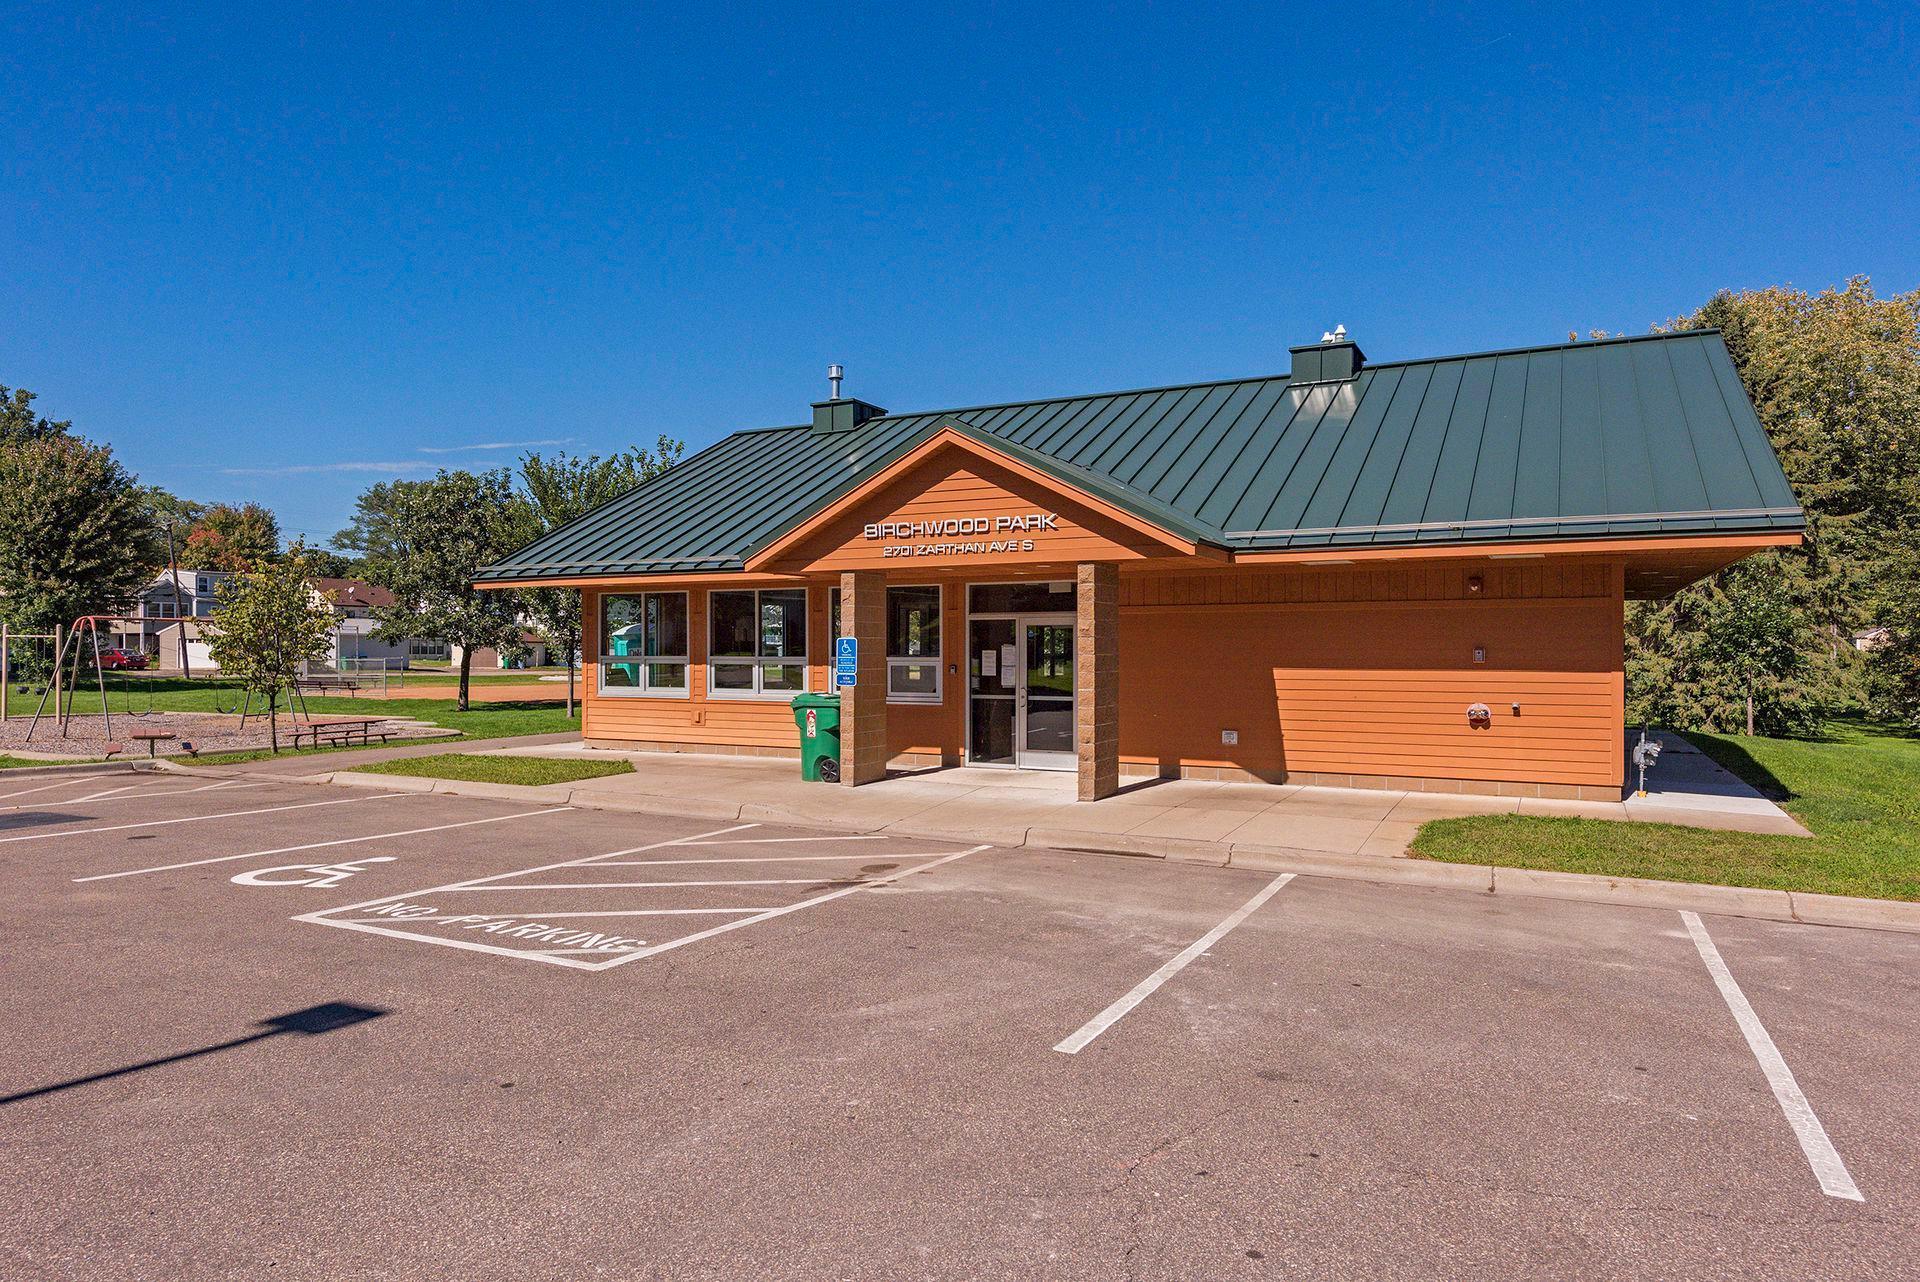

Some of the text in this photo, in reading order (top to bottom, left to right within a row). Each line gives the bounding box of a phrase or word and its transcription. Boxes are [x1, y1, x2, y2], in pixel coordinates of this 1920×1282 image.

[864, 513, 1060, 539] BIRCHWOOD PARK
[883, 540, 1034, 557] 2701 ZARTHAN AVE S
[363, 902, 647, 950] NO PARKING
